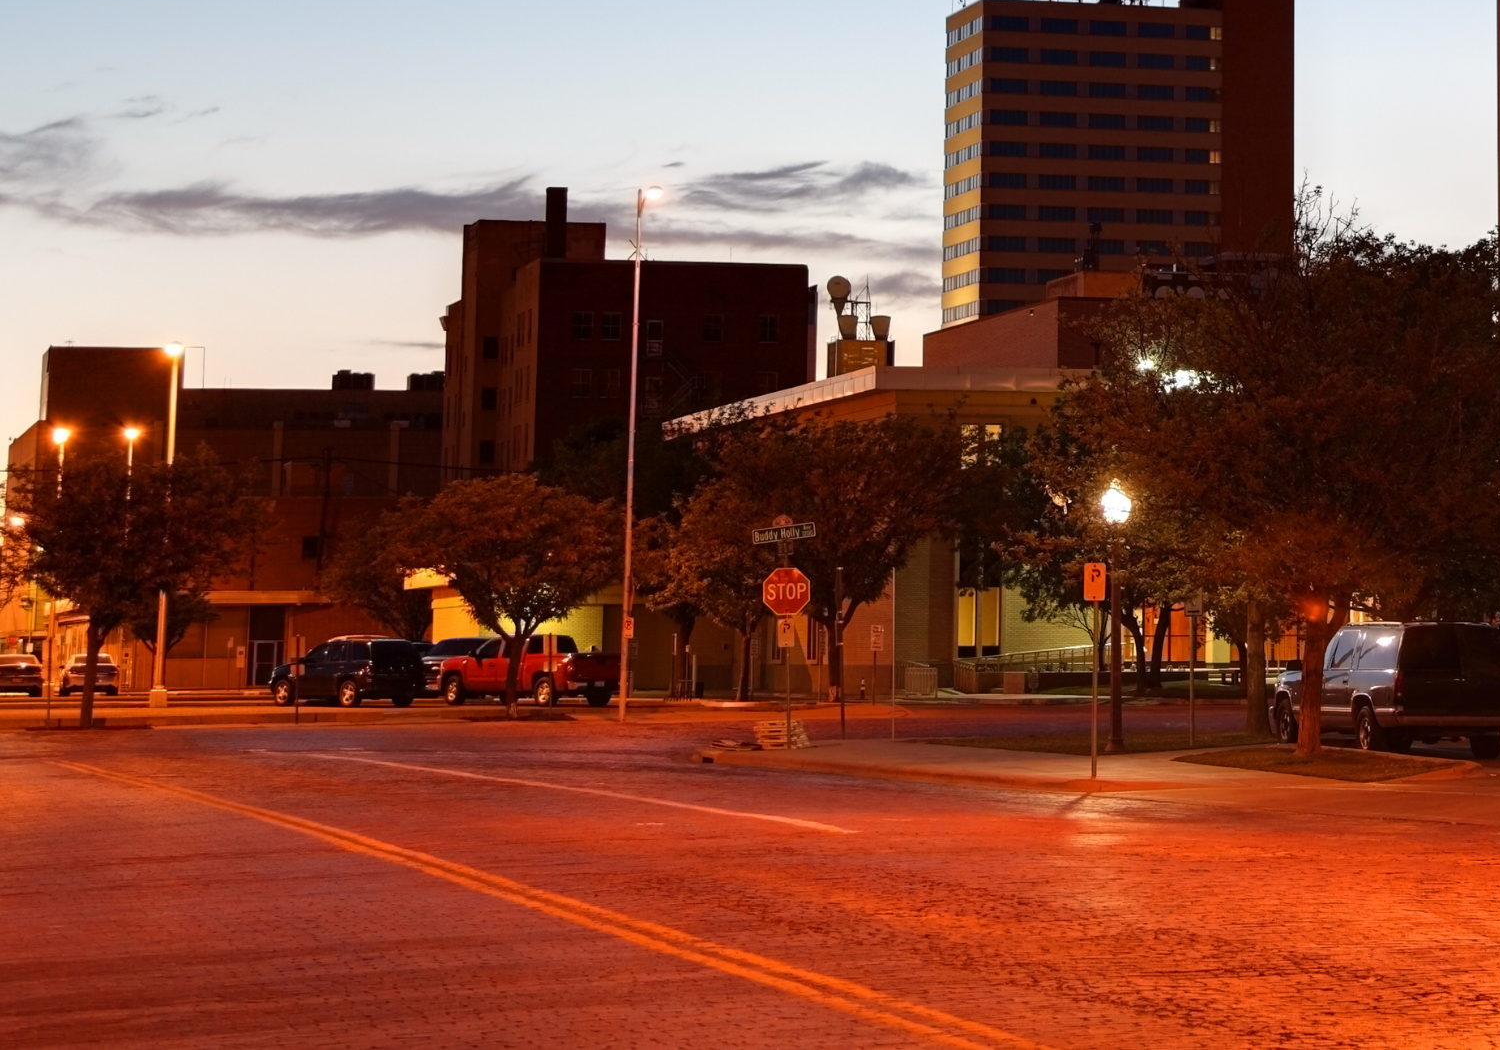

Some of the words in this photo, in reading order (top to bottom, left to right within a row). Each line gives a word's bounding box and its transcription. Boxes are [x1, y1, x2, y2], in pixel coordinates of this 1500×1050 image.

[754, 530, 778, 542] Buddy
[780, 527, 800, 538] Holly
[767, 583, 806, 600] STOP
